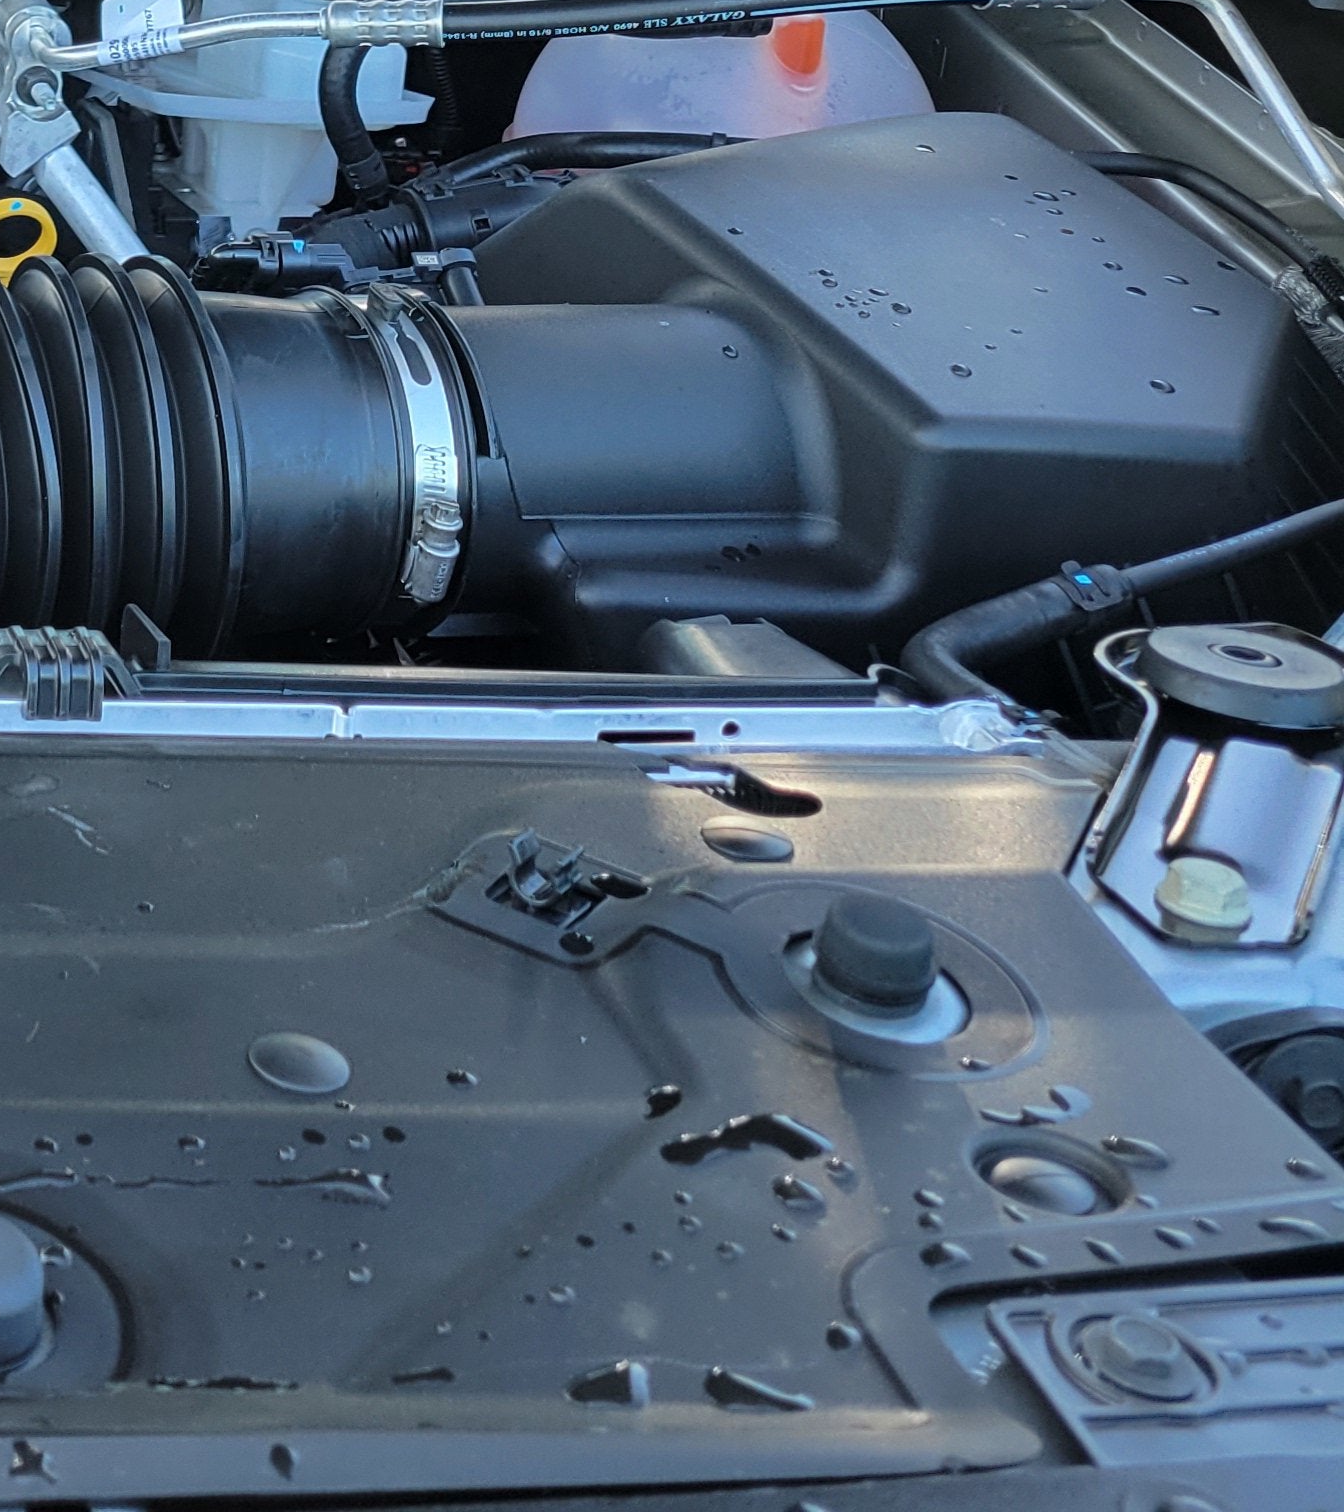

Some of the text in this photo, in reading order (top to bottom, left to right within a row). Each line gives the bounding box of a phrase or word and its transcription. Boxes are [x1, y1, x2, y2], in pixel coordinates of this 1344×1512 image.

[670, 10, 746, 27] GALAXY
[590, 24, 610, 32] A/C
[643, 18, 668, 29] SLE
[555, 27, 587, 35] HOSE
